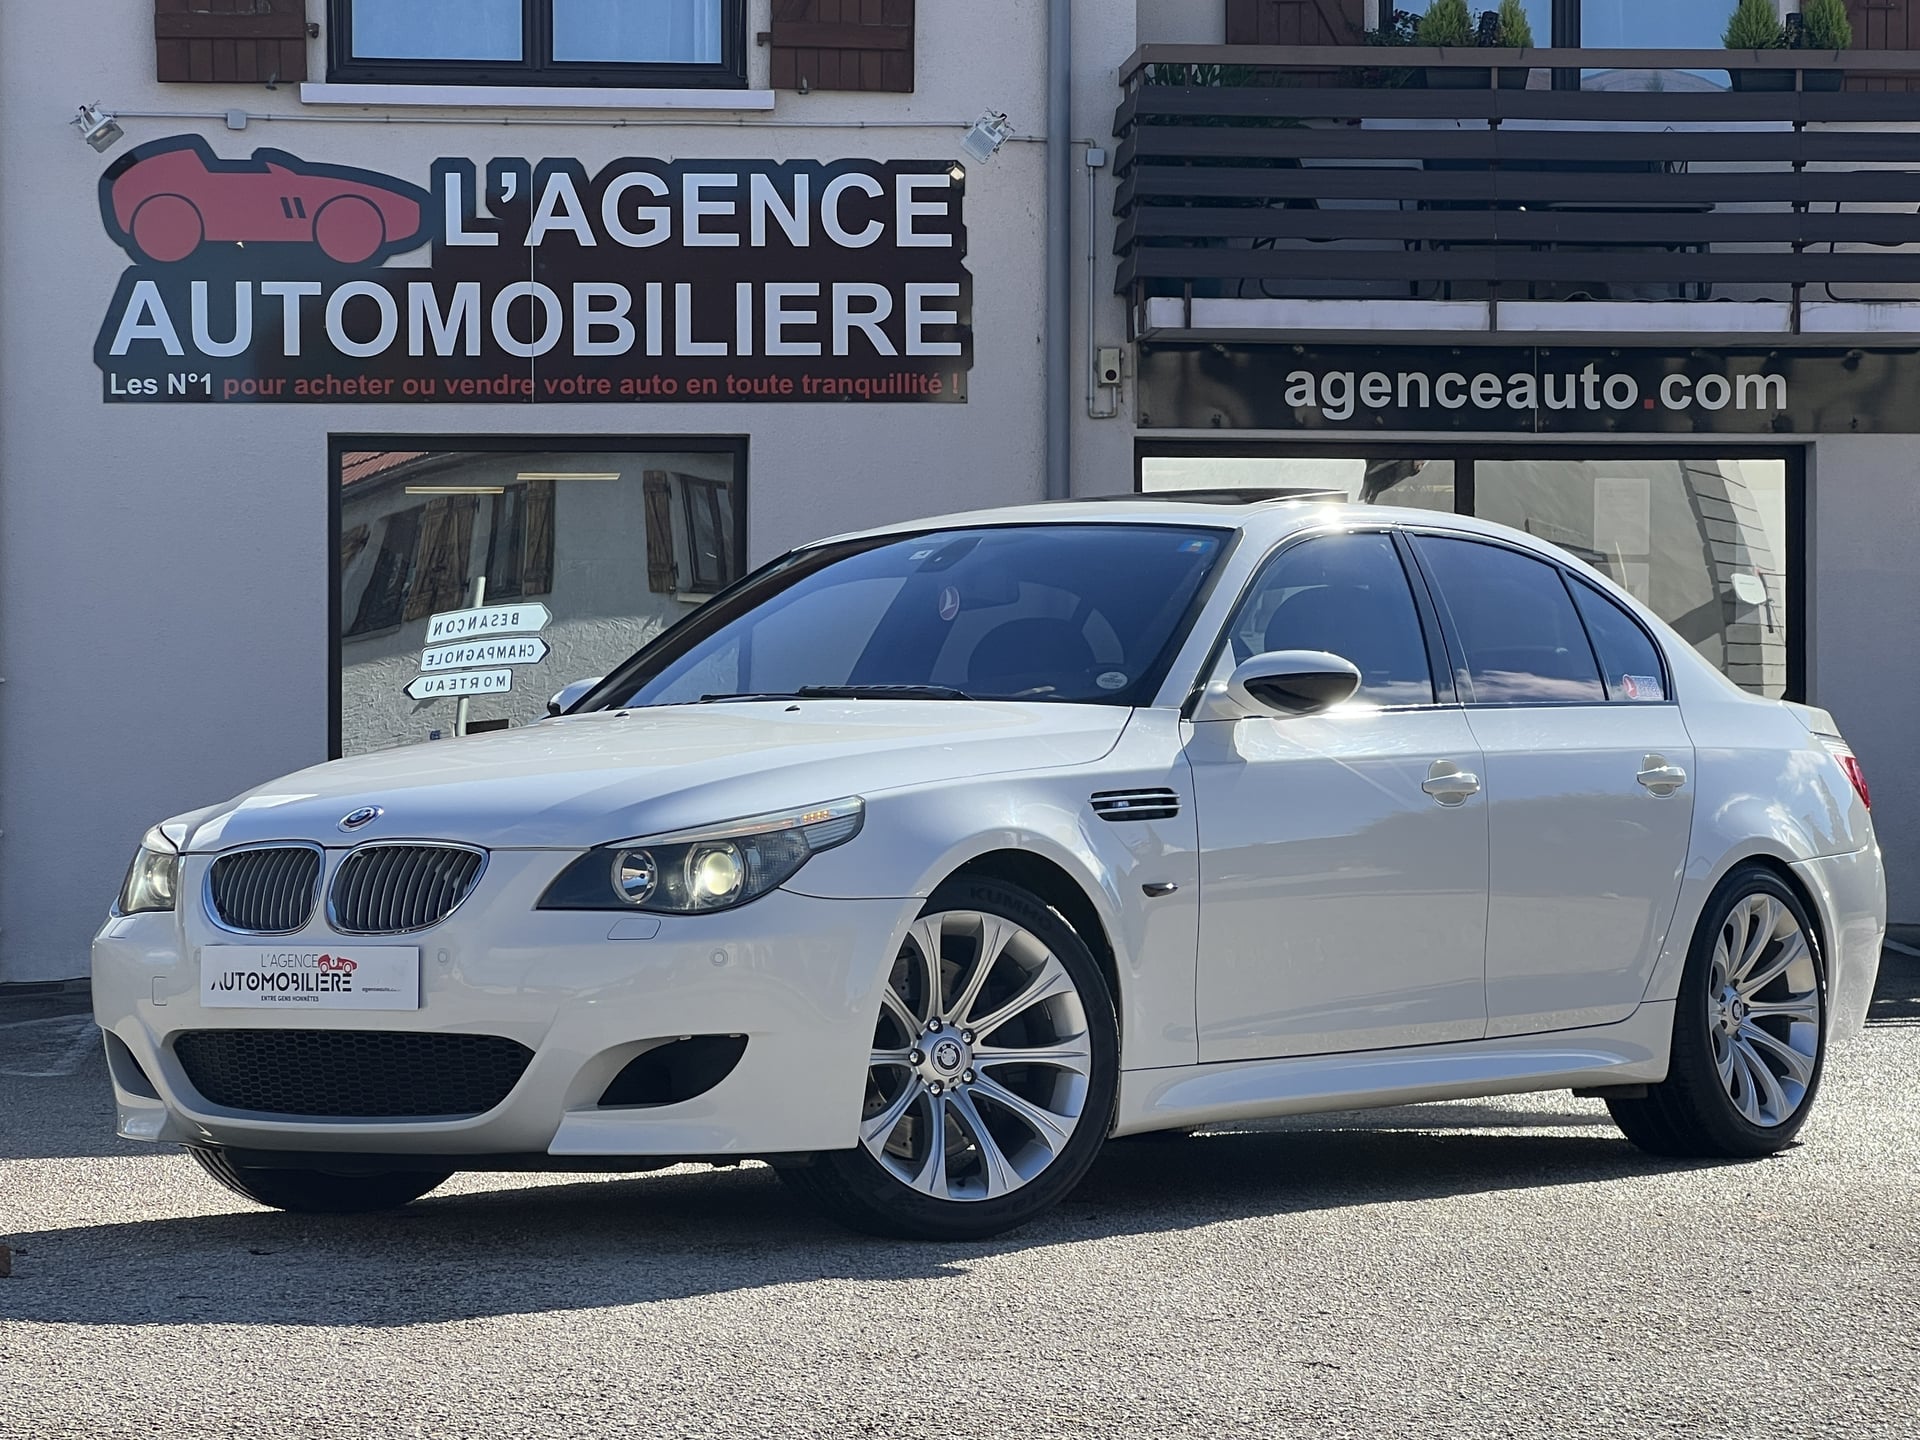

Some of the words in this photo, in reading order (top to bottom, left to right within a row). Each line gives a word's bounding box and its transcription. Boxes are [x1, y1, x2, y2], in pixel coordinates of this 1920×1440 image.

[445, 172, 954, 248] L'AGENCE
[109, 280, 962, 358] AUTOMOBILIERE
[110, 373, 159, 395] Les
[167, 373, 212, 395] N°1
[223, 378, 286, 400] pour
[294, 374, 394, 395] acheter
[402, 379, 435, 395] ou
[444, 374, 535, 395] vendre
[544, 374, 611, 395] votre
[620, 374, 678, 395] auto
[686, 378, 717, 394] en
[726, 374, 793, 394] toute
[801, 374, 942, 400] tranquillité
[1284, 361, 1788, 420] agenceauto.com
[261, 953, 318, 968] L'AGENCE
